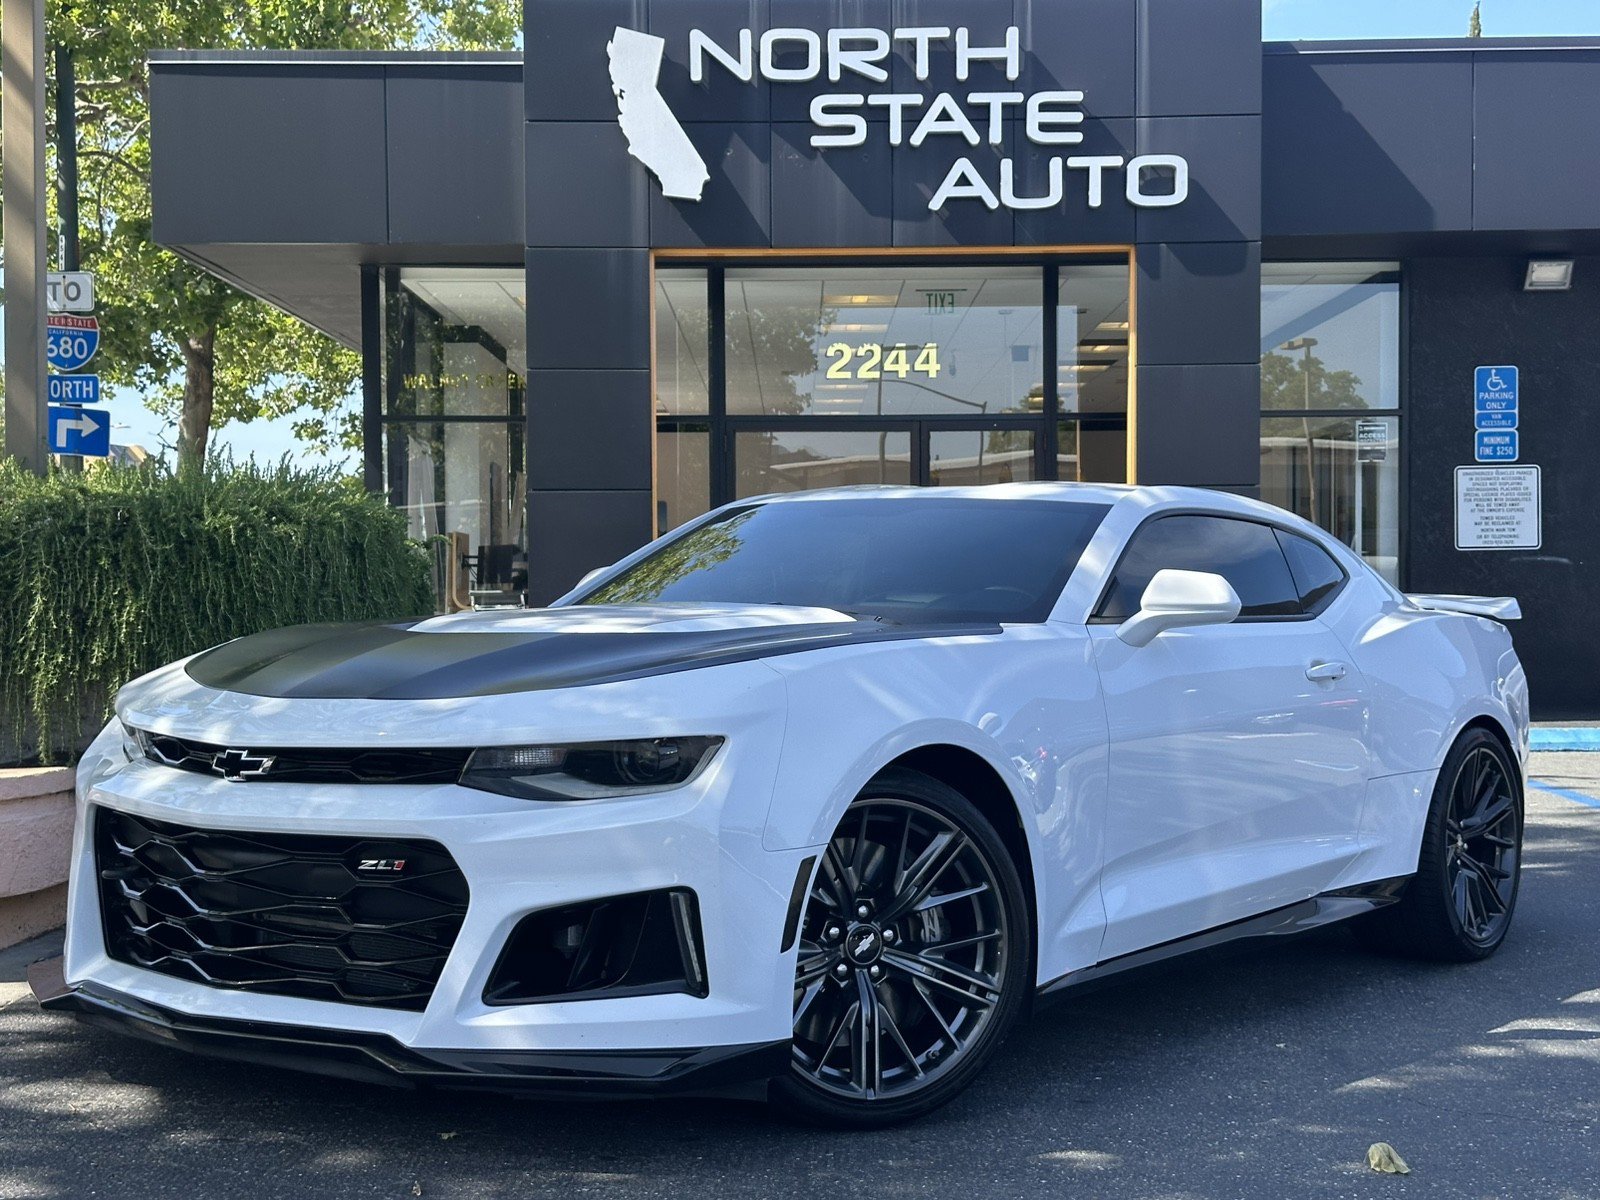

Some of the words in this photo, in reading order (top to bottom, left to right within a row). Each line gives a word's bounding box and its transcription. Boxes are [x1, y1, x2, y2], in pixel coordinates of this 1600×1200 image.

[689, 27, 1019, 83] NORTH
[810, 91, 1084, 147] STATE
[928, 154, 1189, 211] AUTO
[47, 281, 81, 301] TO
[48, 317, 92, 328] TERSTATE
[48, 336, 88, 360] 680
[826, 342, 941, 379] 2244
[50, 380, 94, 399] ORTH
[1479, 392, 1514, 400] PARKING
[1486, 402, 1506, 410] ONLY
[1484, 436, 1510, 444] MINIMUM
[1480, 446, 1494, 455] FINE
[1496, 446, 1514, 455] $250
[358, 860, 405, 870] ZL1
